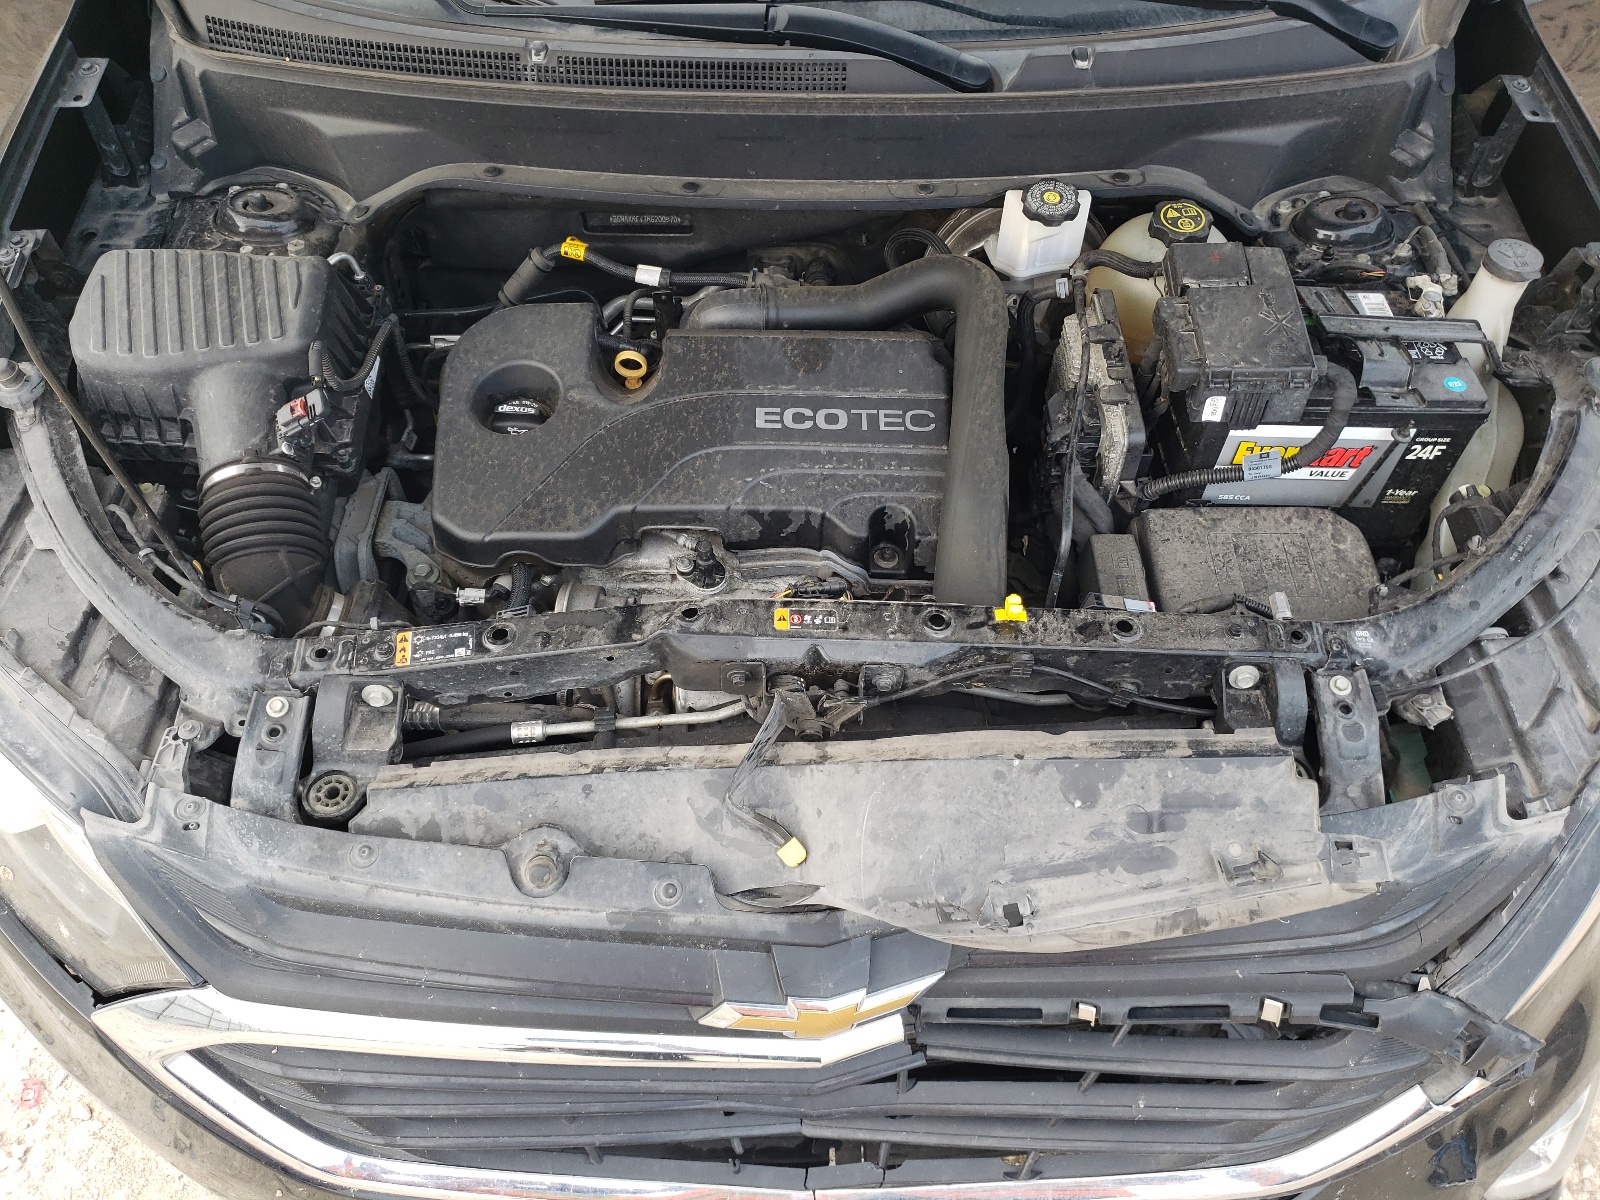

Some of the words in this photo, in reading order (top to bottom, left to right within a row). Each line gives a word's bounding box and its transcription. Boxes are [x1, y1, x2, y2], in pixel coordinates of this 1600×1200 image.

[497, 404, 536, 414] dexos
[755, 407, 936, 432] ECOTEC
[1405, 444, 1447, 460] 24F
[1308, 470, 1349, 478] VALUE
[1385, 488, 1419, 496] 1-Year
